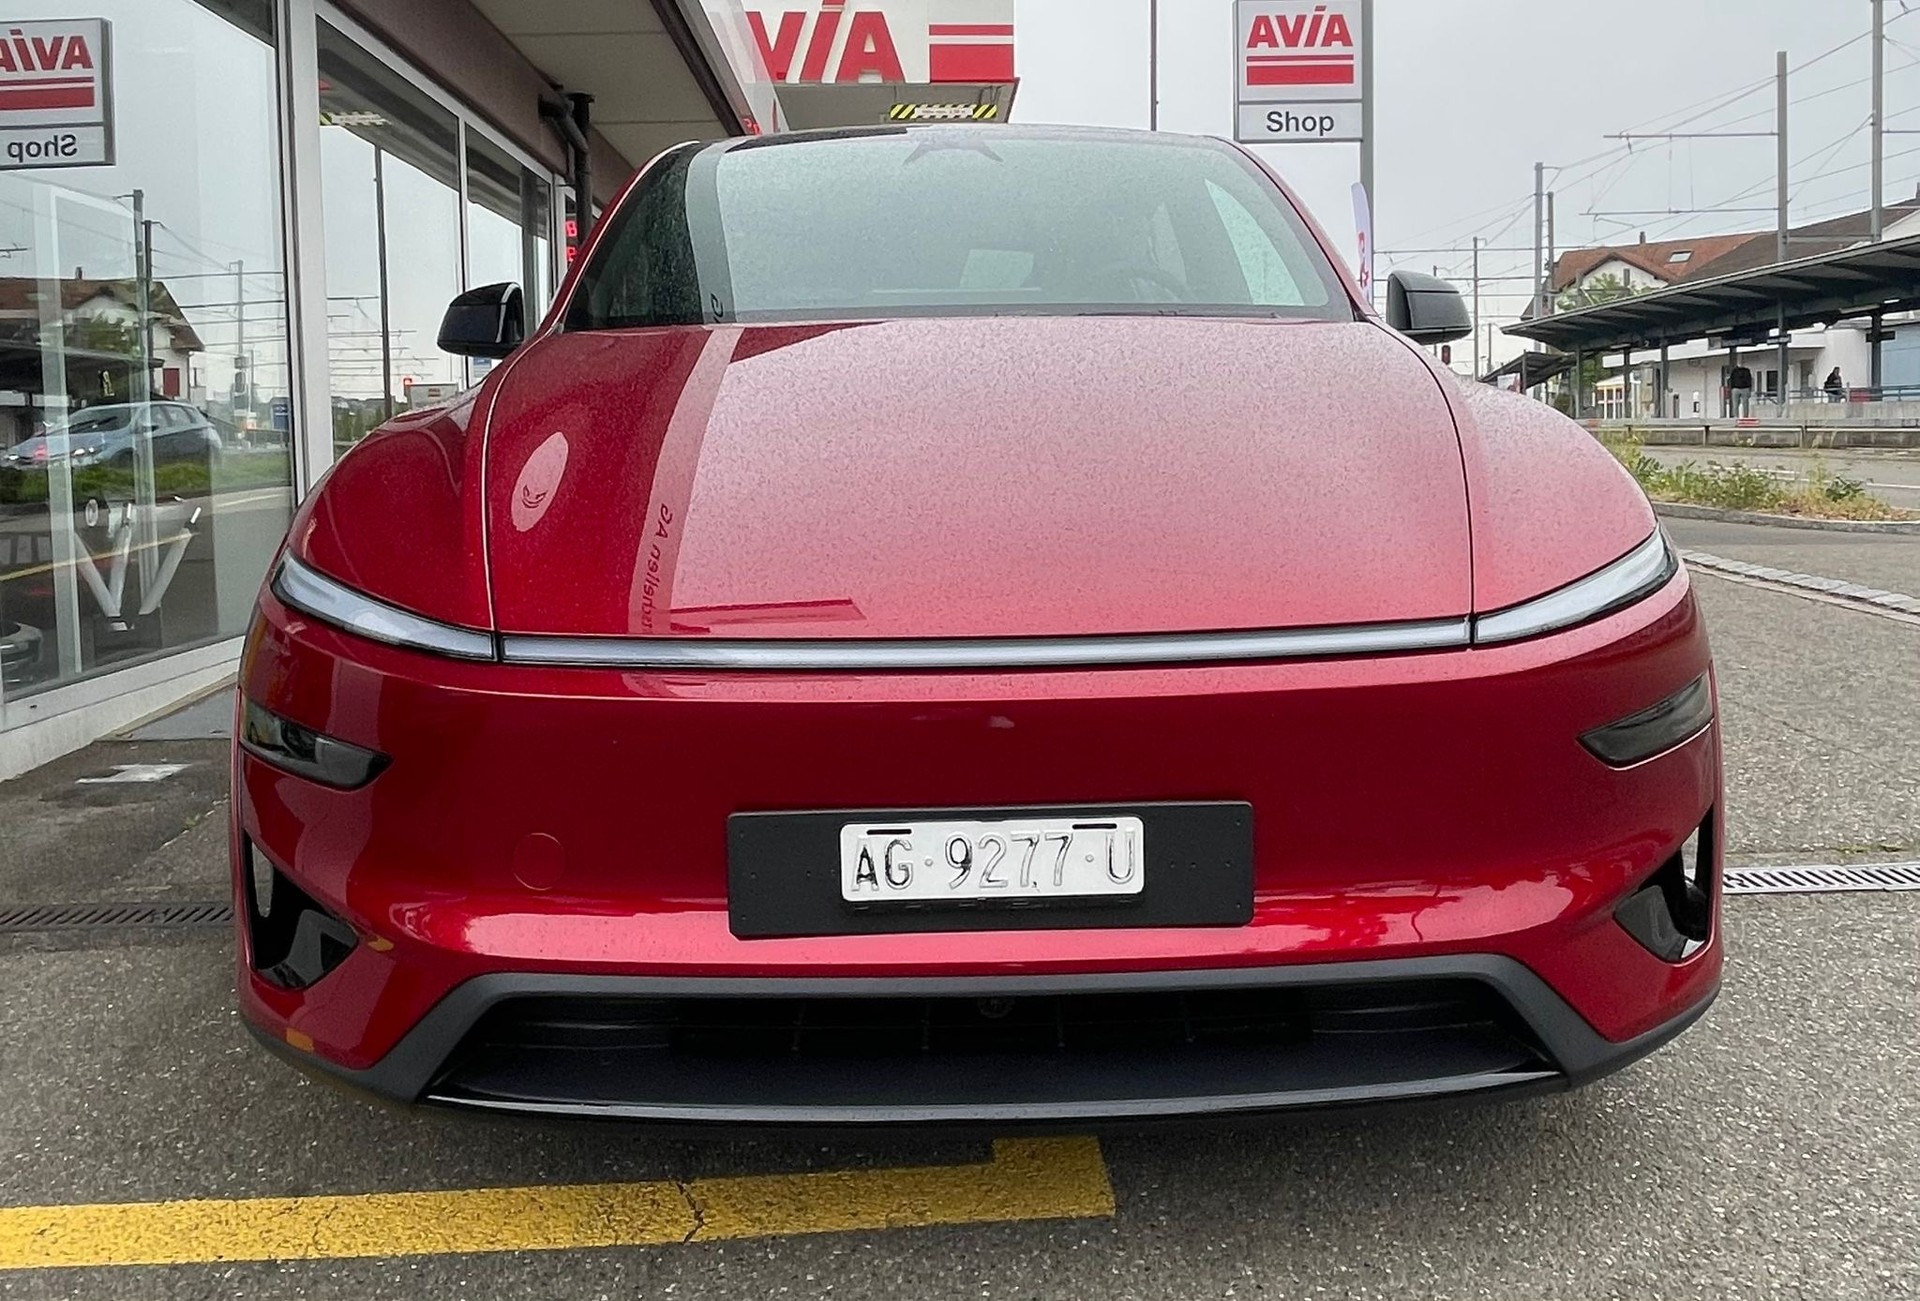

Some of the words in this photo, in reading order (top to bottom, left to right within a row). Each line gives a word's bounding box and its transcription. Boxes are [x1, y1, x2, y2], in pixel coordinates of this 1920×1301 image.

[1266, 111, 1335, 136] Shop
[851, 836, 914, 891] AG
[945, 830, 1073, 889] 9277
[1105, 827, 1136, 884] U
